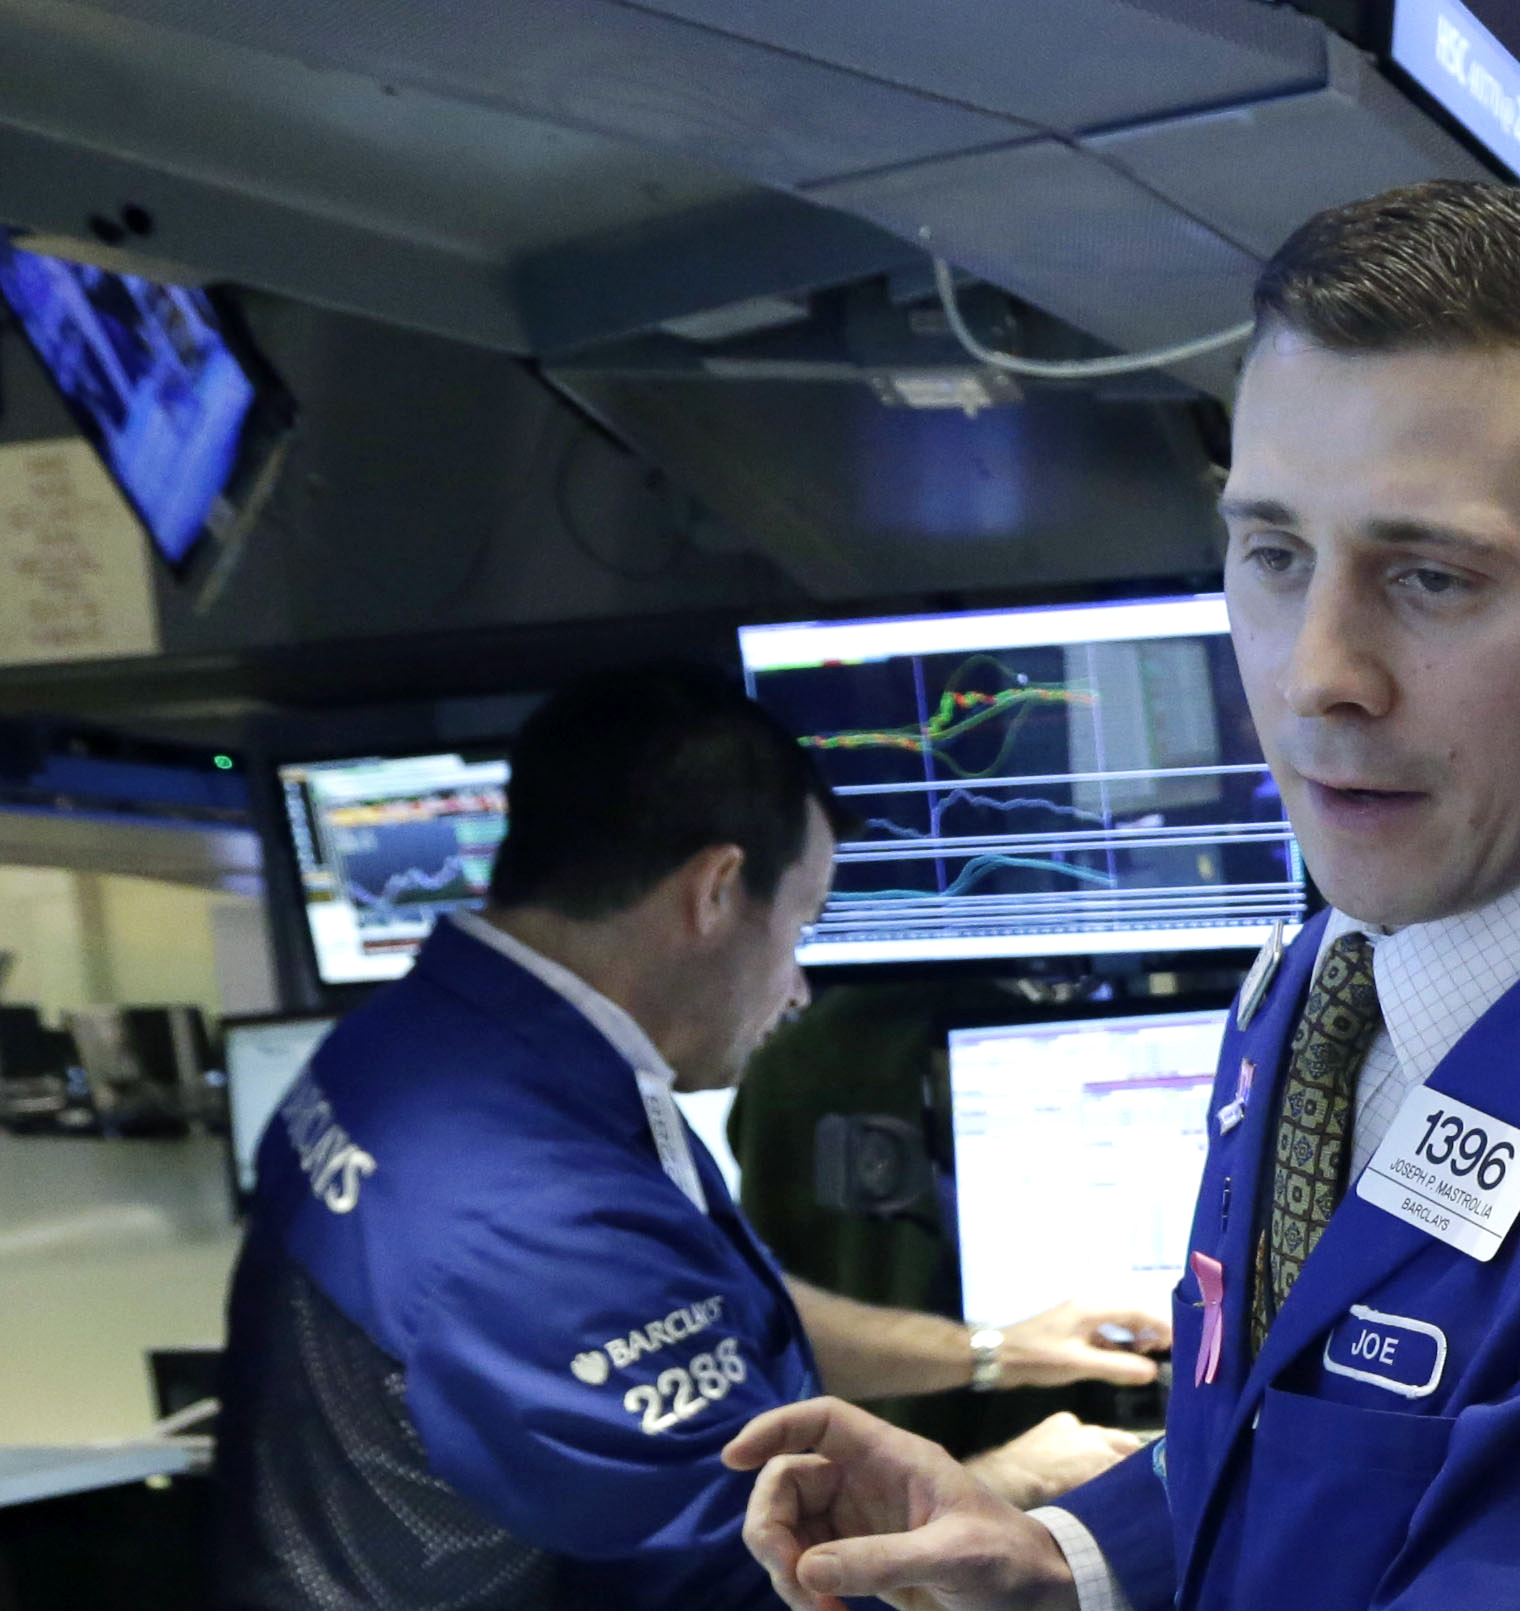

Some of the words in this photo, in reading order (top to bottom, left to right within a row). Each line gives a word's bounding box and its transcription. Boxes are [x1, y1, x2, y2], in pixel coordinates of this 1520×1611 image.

[1415, 1110, 1515, 1191] 1396
[1390, 1158, 1427, 1187] JOSEPH
[1425, 1174, 1436, 1190] P.
[1435, 1181, 1492, 1219] MASTROLIA
[1401, 1197, 1450, 1232] BARCLAYS
[1351, 1329, 1399, 1366] JOE
